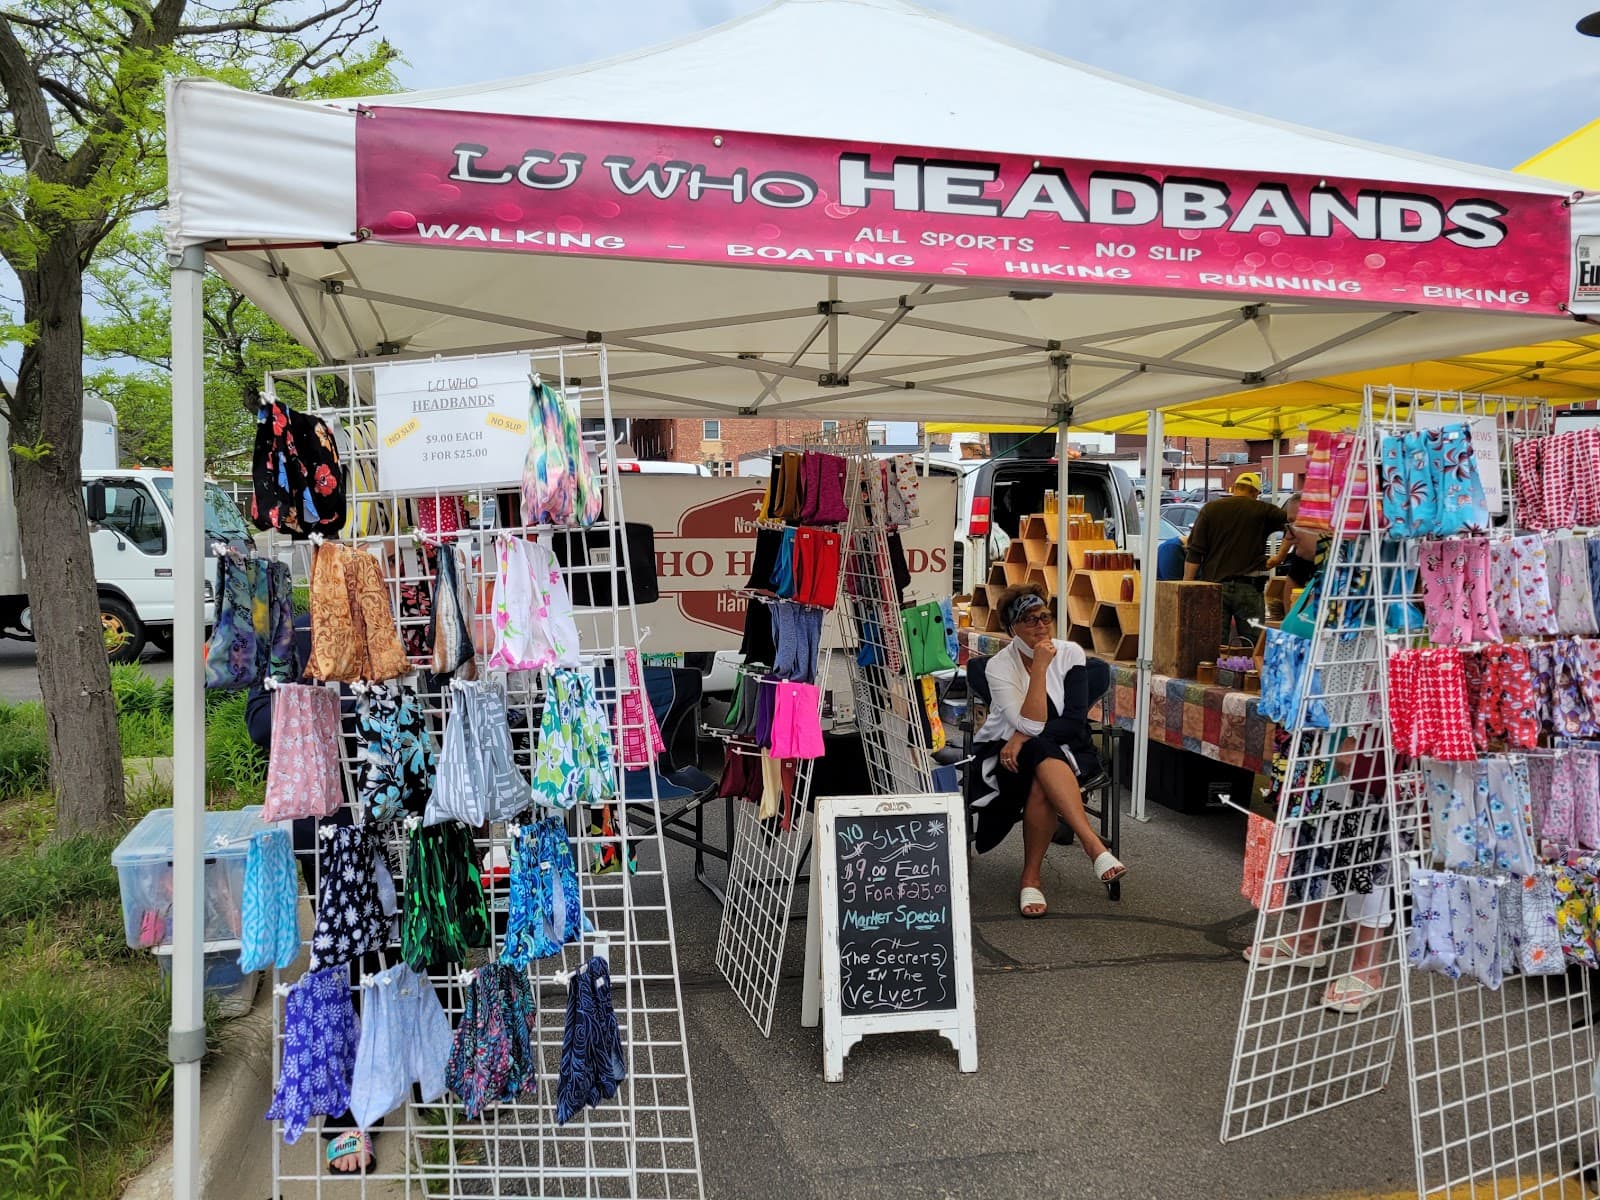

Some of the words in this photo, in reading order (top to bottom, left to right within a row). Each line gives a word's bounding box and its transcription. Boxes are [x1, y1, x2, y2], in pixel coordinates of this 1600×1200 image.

[449, 143, 586, 190] LU
[602, 154, 818, 208] WHO
[838, 151, 1508, 249] HEADBANDS
[854, 226, 906, 244] ALL
[919, 231, 1035, 253] SPORTS
[1095, 242, 1136, 259] NO
[1148, 245, 1202, 263] SLIP
[416, 222, 627, 250] WALKING
[726, 244, 915, 268] BOATING
[1004, 260, 1133, 280] HIKING
[1198, 272, 1362, 294] RUNNING
[1422, 285, 1531, 305] BIKING
[448, 377, 479, 390] WHO
[412, 394, 496, 413] HEADBANDS
[388, 433, 402, 445] NO
[401, 422, 417, 437] SLIP
[491, 417, 504, 426] NO
[505, 421, 522, 432] SLIP
[426, 433, 453, 444] $9.00
[456, 431, 483, 442] EACH
[422, 452, 429, 462] 3
[431, 450, 451, 461] FOR
[453, 448, 488, 460] $25.00
[654, 550, 714, 577] HO
[838, 824, 864, 851] NO
[872, 820, 922, 850] SLIP
[841, 858, 887, 882] $9.00
[895, 857, 940, 881] Each
[842, 882, 857, 903] 3
[897, 882, 947, 901] $25.00
[895, 905, 946, 930] Special
[841, 951, 871, 967] The
[893, 968, 924, 982] The
